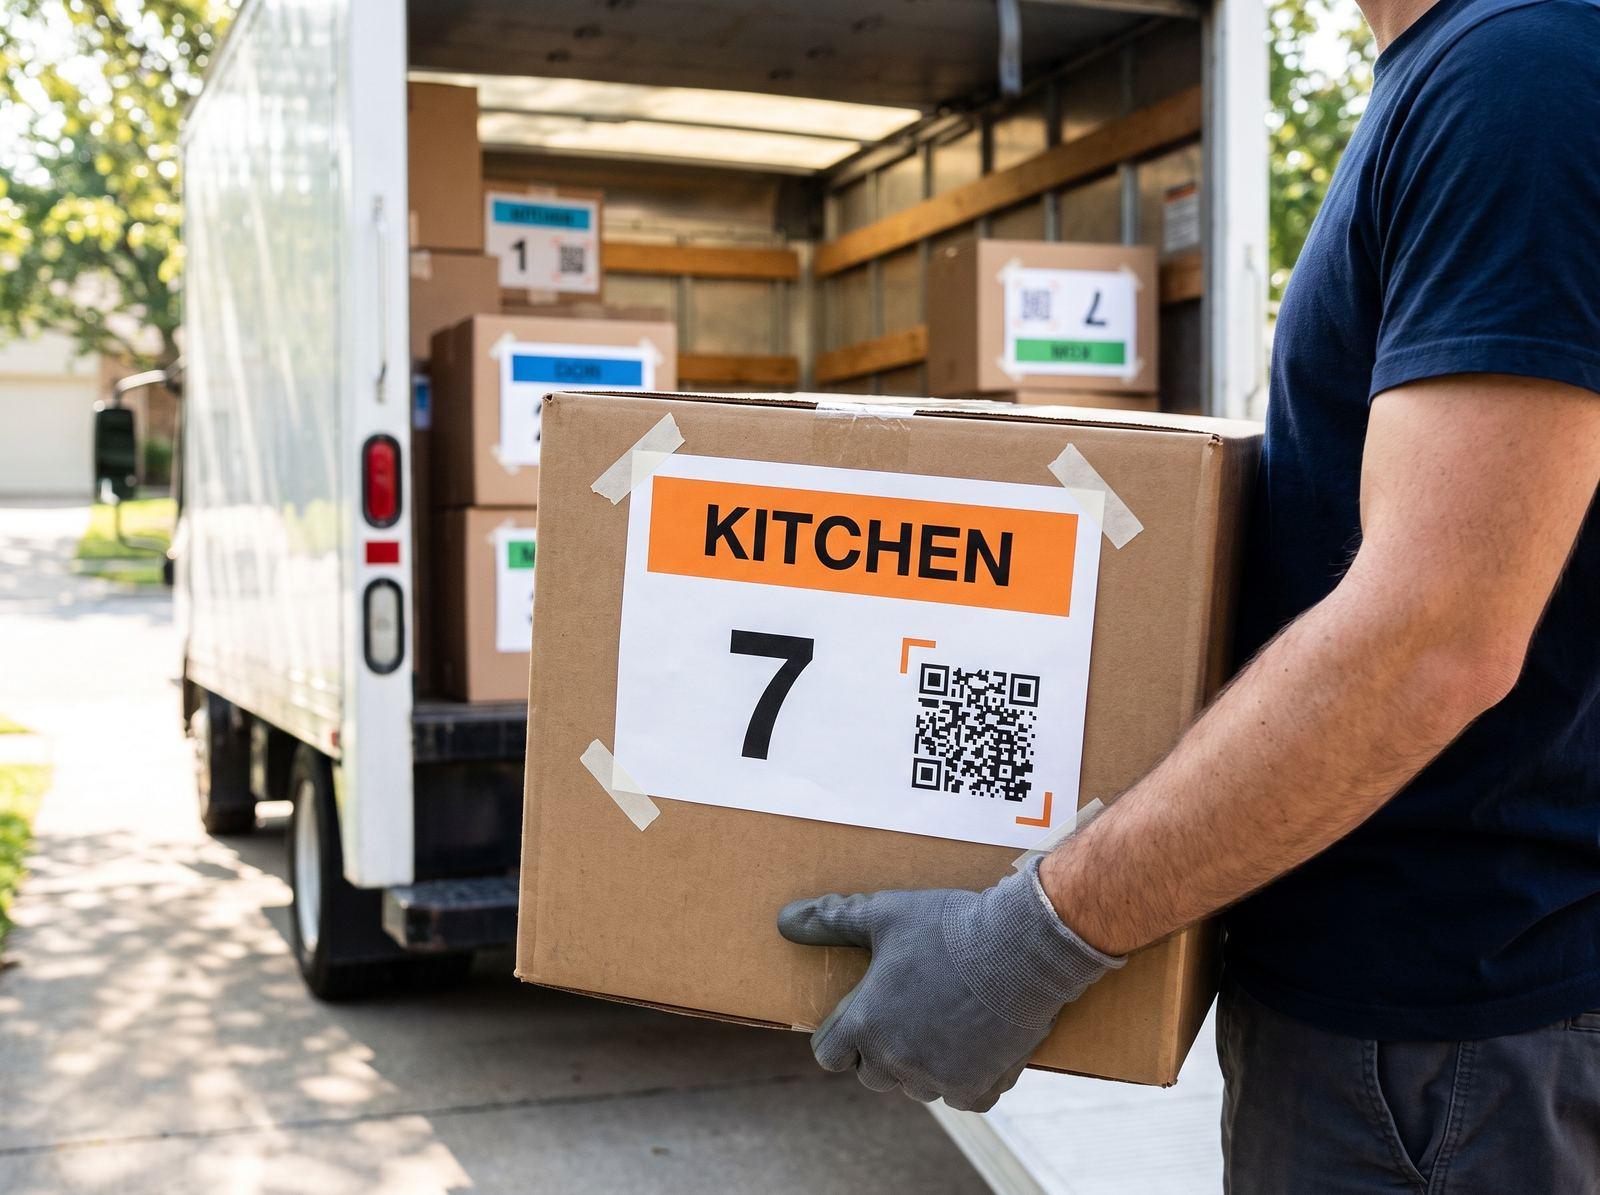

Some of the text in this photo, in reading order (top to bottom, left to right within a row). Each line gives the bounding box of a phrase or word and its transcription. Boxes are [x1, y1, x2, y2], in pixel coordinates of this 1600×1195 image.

[511, 239, 526, 272] 1
[704, 503, 1013, 587] KITCHEN
[729, 629, 815, 760] 7
